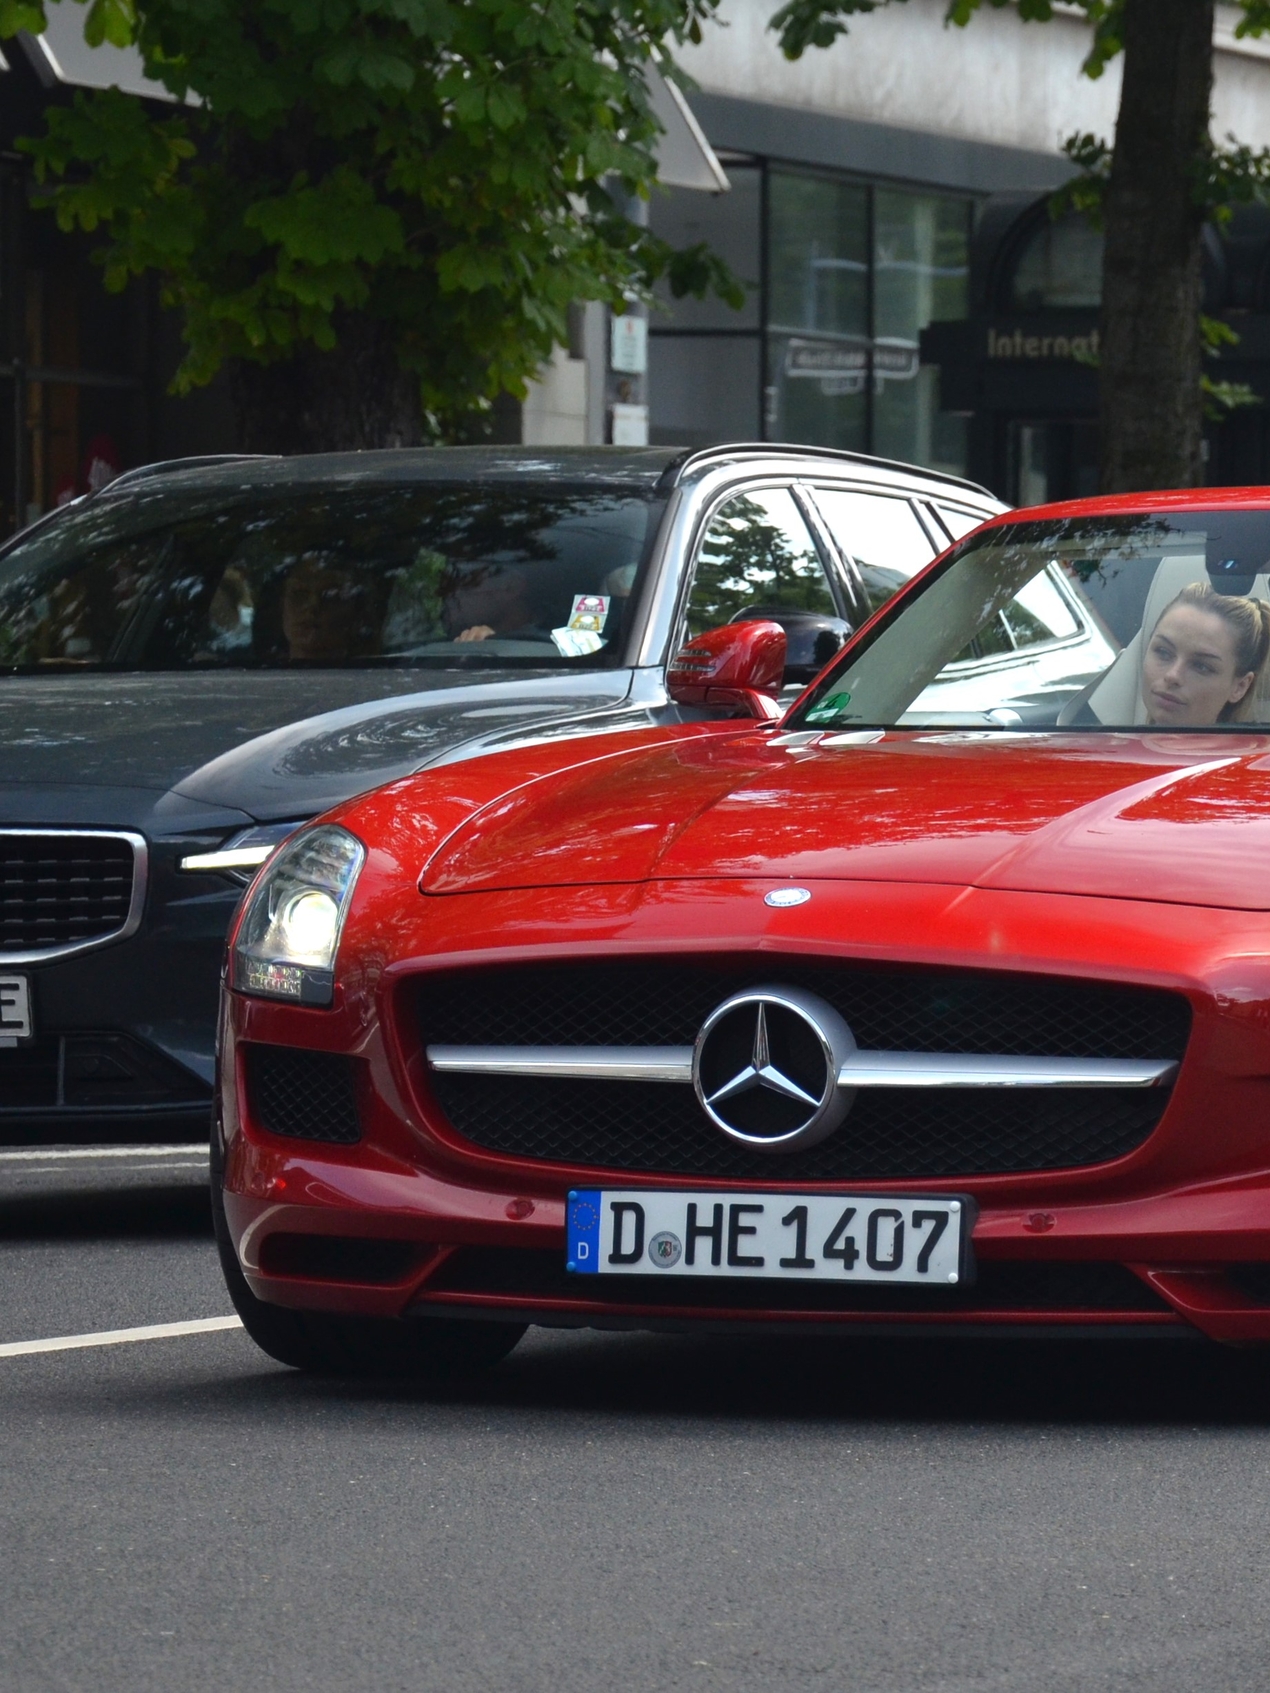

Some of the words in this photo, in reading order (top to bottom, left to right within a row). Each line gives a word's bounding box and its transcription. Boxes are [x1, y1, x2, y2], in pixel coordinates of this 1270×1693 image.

[577, 1242, 589, 1259] D
[608, 1201, 645, 1264] D
[684, 1202, 765, 1266] HE
[779, 1205, 949, 1273] 1407
